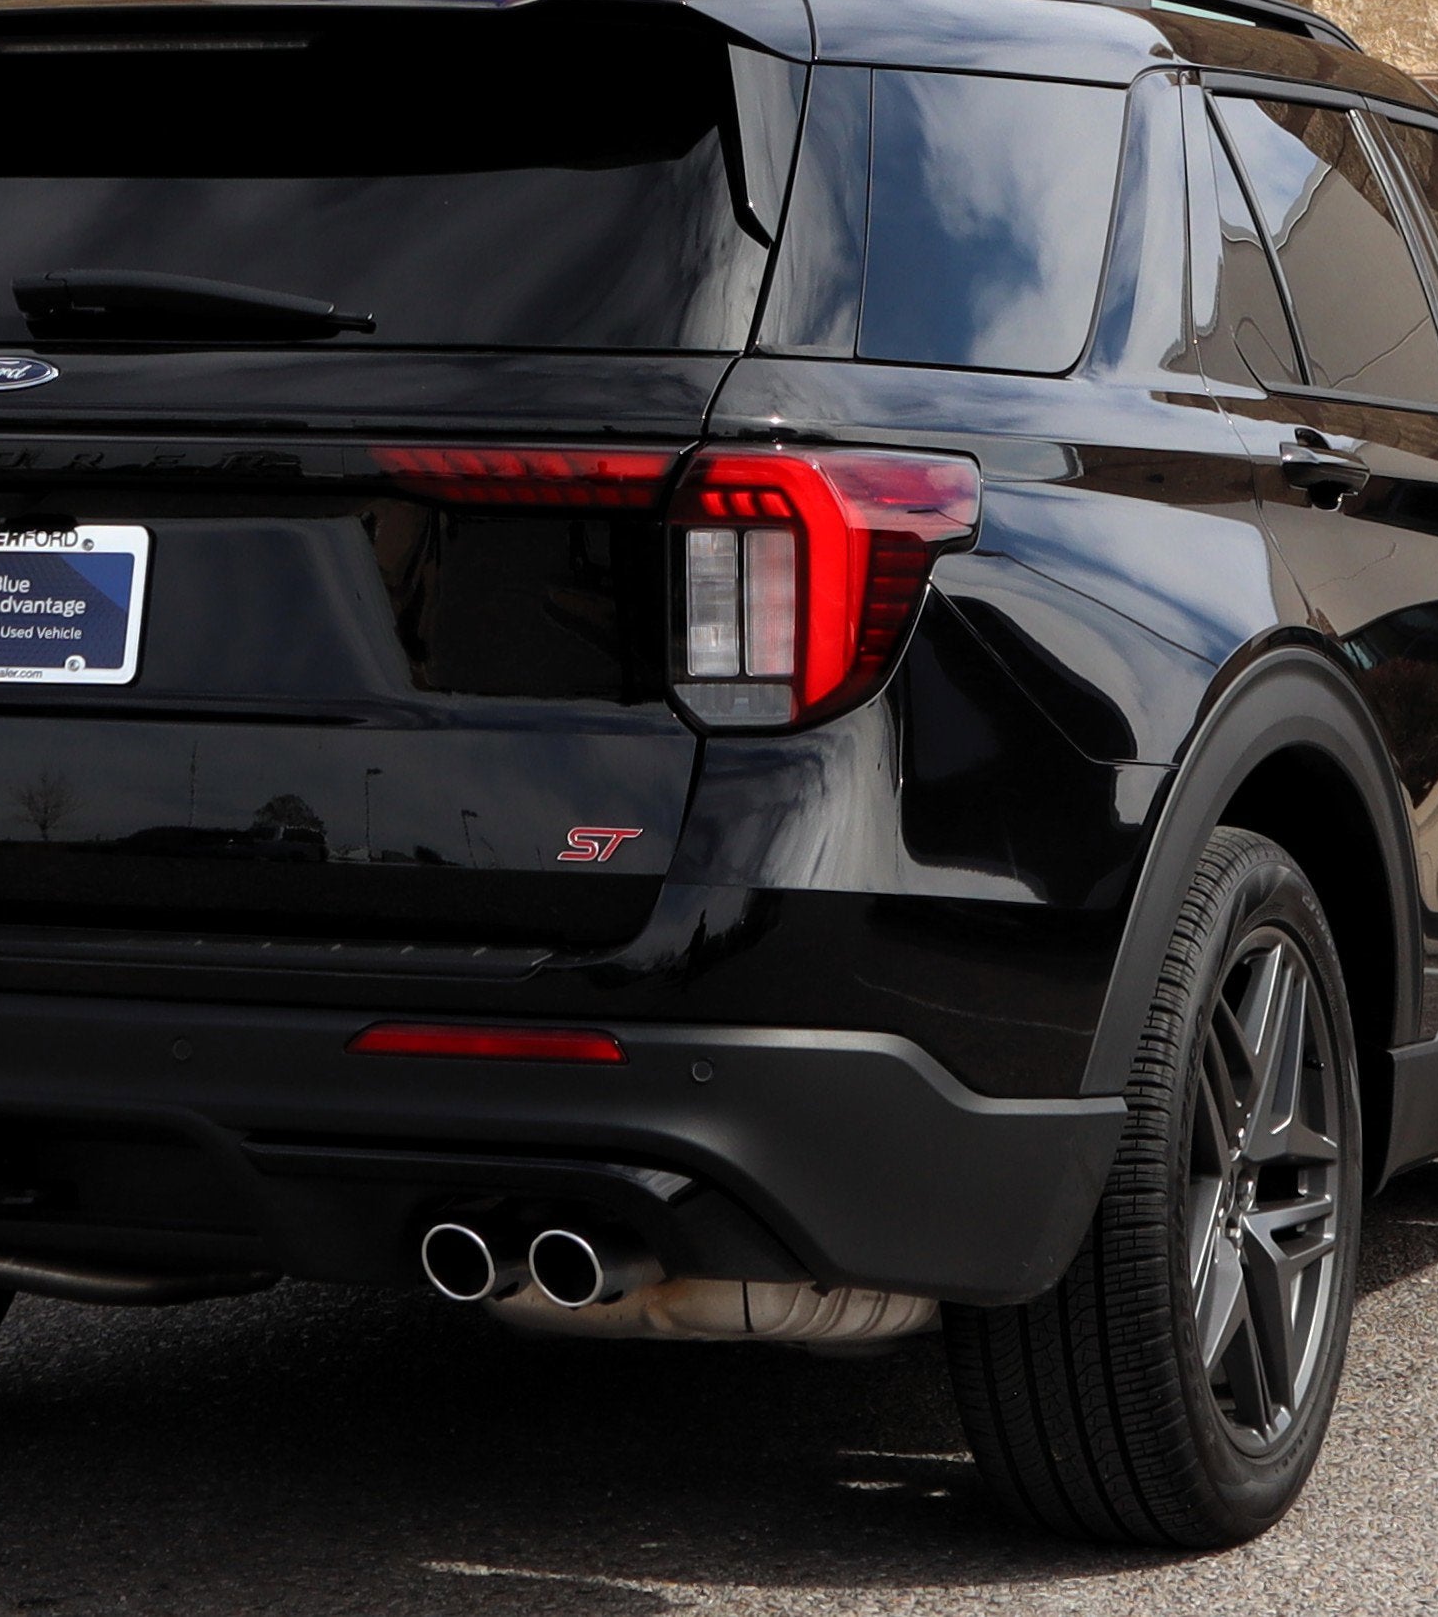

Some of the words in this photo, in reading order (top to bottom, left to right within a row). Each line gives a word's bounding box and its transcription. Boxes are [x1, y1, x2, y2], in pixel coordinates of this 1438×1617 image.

[0, 626, 34, 639] Used
[36, 626, 83, 641] Vehicle
[556, 826, 644, 862] ST
